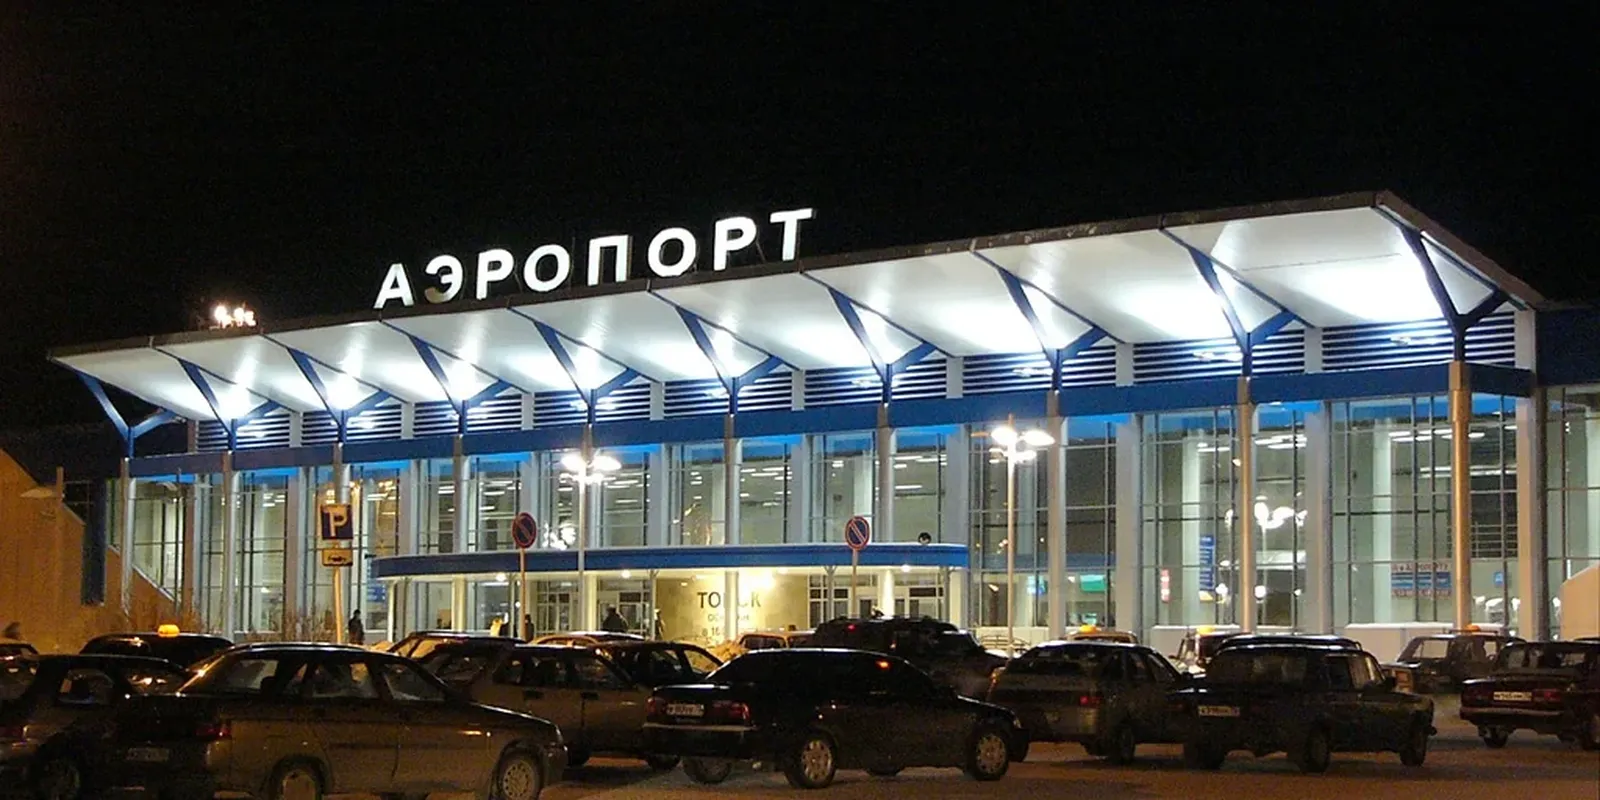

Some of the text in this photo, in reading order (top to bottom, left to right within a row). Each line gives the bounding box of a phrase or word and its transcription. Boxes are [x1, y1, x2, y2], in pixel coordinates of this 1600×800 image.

[374, 208, 814, 309] АЭРОПОРТ
[327, 507, 348, 537] P
[697, 591, 761, 609] ТОК
